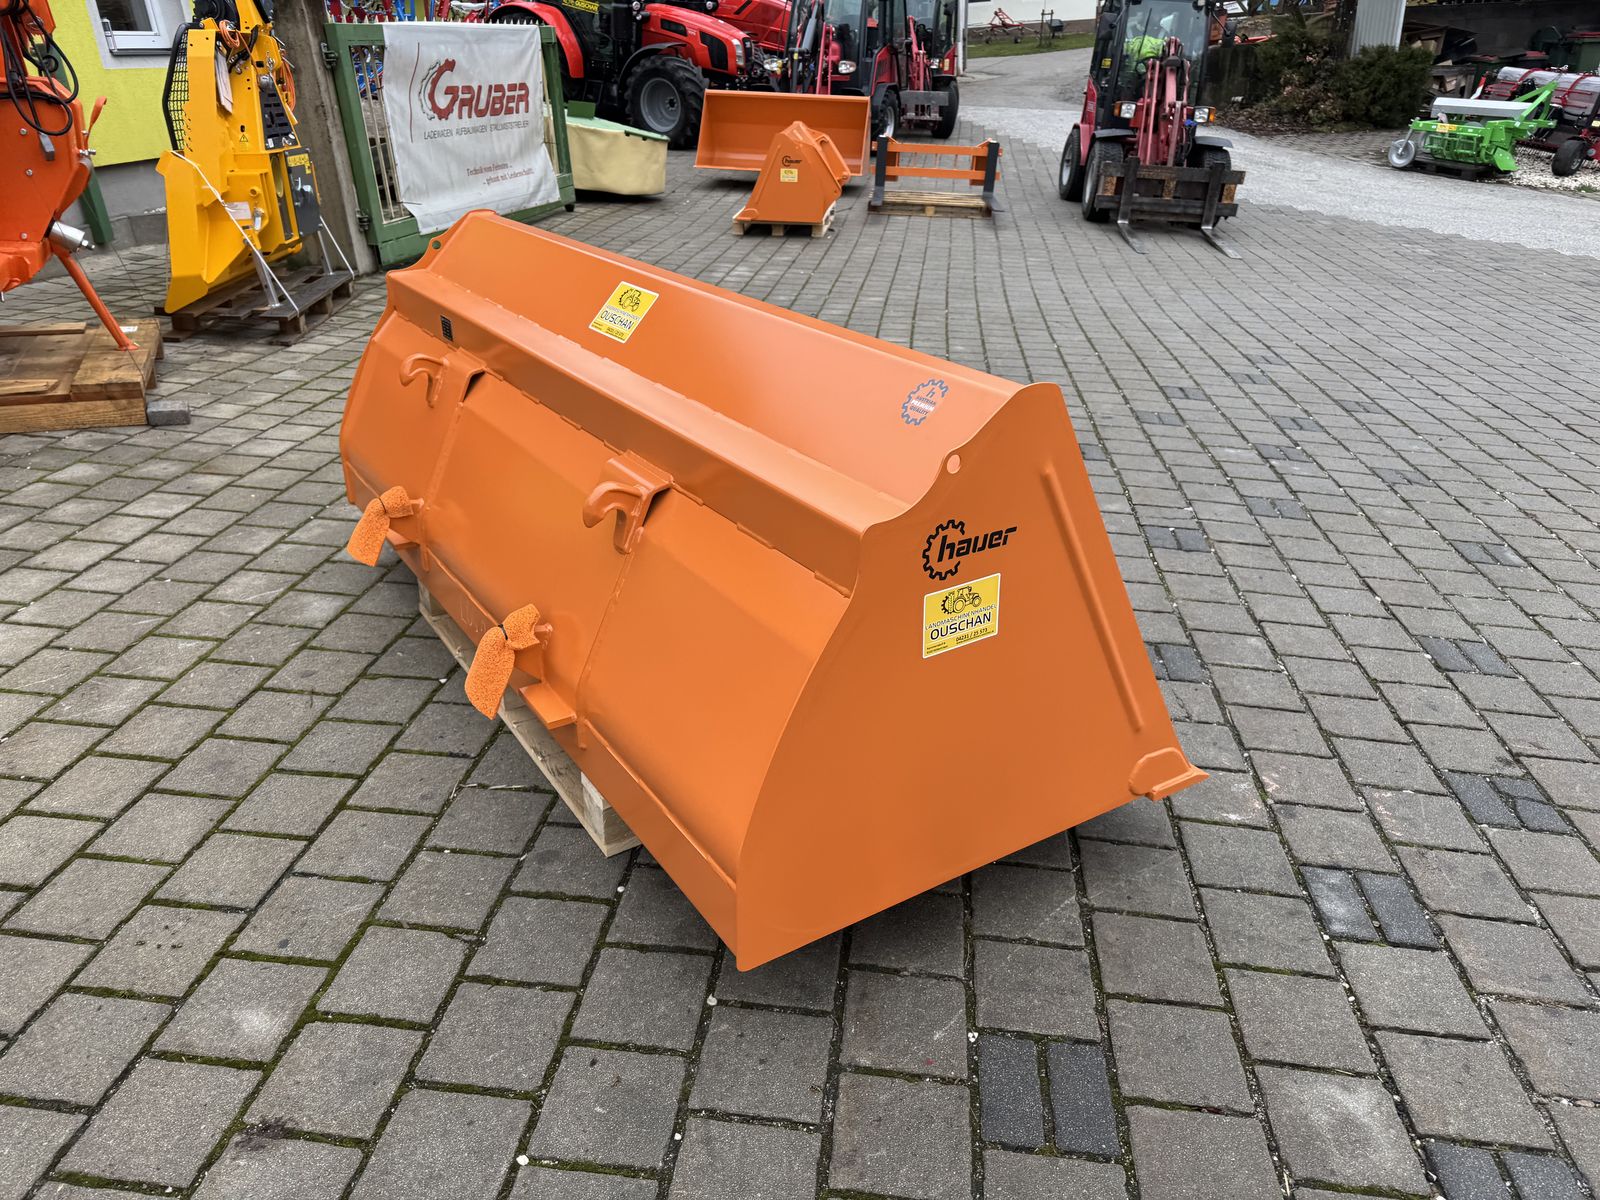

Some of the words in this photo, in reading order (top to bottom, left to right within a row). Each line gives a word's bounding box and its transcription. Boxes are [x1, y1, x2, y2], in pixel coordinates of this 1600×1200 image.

[428, 58, 529, 120] GRUBER
[423, 127, 453, 140] LADEWAGEN
[600, 310, 635, 330] OUSCHAN
[937, 526, 1018, 563] hauer
[925, 603, 997, 631] LANDMASCHINENHANDEL
[930, 611, 992, 641] OUSCHAN
